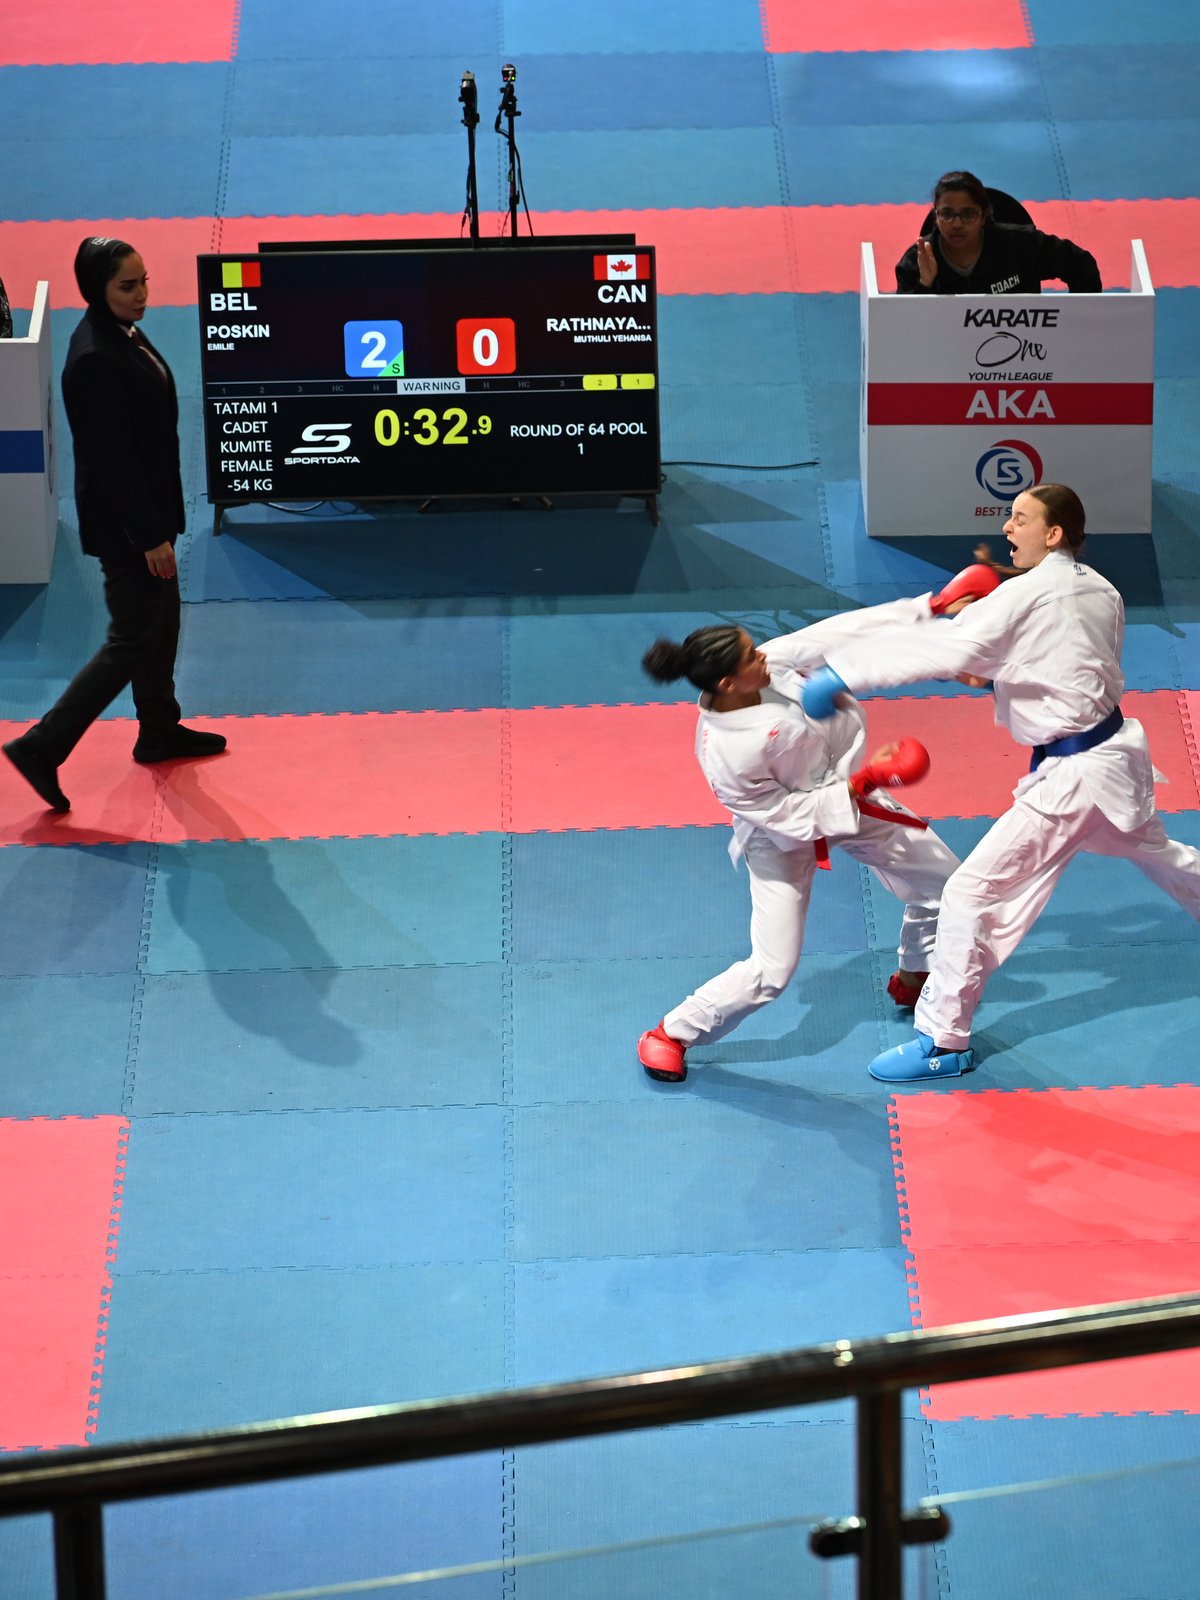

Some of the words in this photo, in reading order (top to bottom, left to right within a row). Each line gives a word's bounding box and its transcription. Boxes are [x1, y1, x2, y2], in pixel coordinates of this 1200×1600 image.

[990, 274, 1020, 294] COACH
[597, 284, 647, 303] CAN
[210, 292, 258, 311] BEL
[546, 316, 652, 332] RATHNAYA...
[963, 308, 1060, 328] KARATE
[206, 324, 270, 339] POSKIN
[573, 334, 612, 343] MUTHULI
[612, 334, 652, 342] YEHANSA
[207, 342, 236, 351] EMILIE
[361, 331, 388, 369] 2
[472, 328, 499, 367] 0
[975, 331, 1047, 368] One
[391, 363, 401, 375] S
[968, 372, 1006, 381] YOUTH
[1007, 371, 1053, 381] LEAGUE
[403, 381, 461, 391] WARNING
[213, 402, 267, 415] TATAMI
[271, 402, 278, 413] 1
[965, 389, 1056, 419] AKA
[222, 421, 268, 434] CADET
[510, 424, 562, 437] ROUND
[565, 424, 585, 436] OF
[588, 423, 605, 436] 64
[609, 422, 647, 435] POOL
[220, 440, 272, 453] KUMITE
[577, 443, 584, 455] 1
[221, 459, 273, 472] FEMALE
[284, 456, 361, 465] SPORTDATA
[227, 480, 250, 492] -54
[254, 479, 273, 491] KG
[975, 507, 1003, 516] BEST
